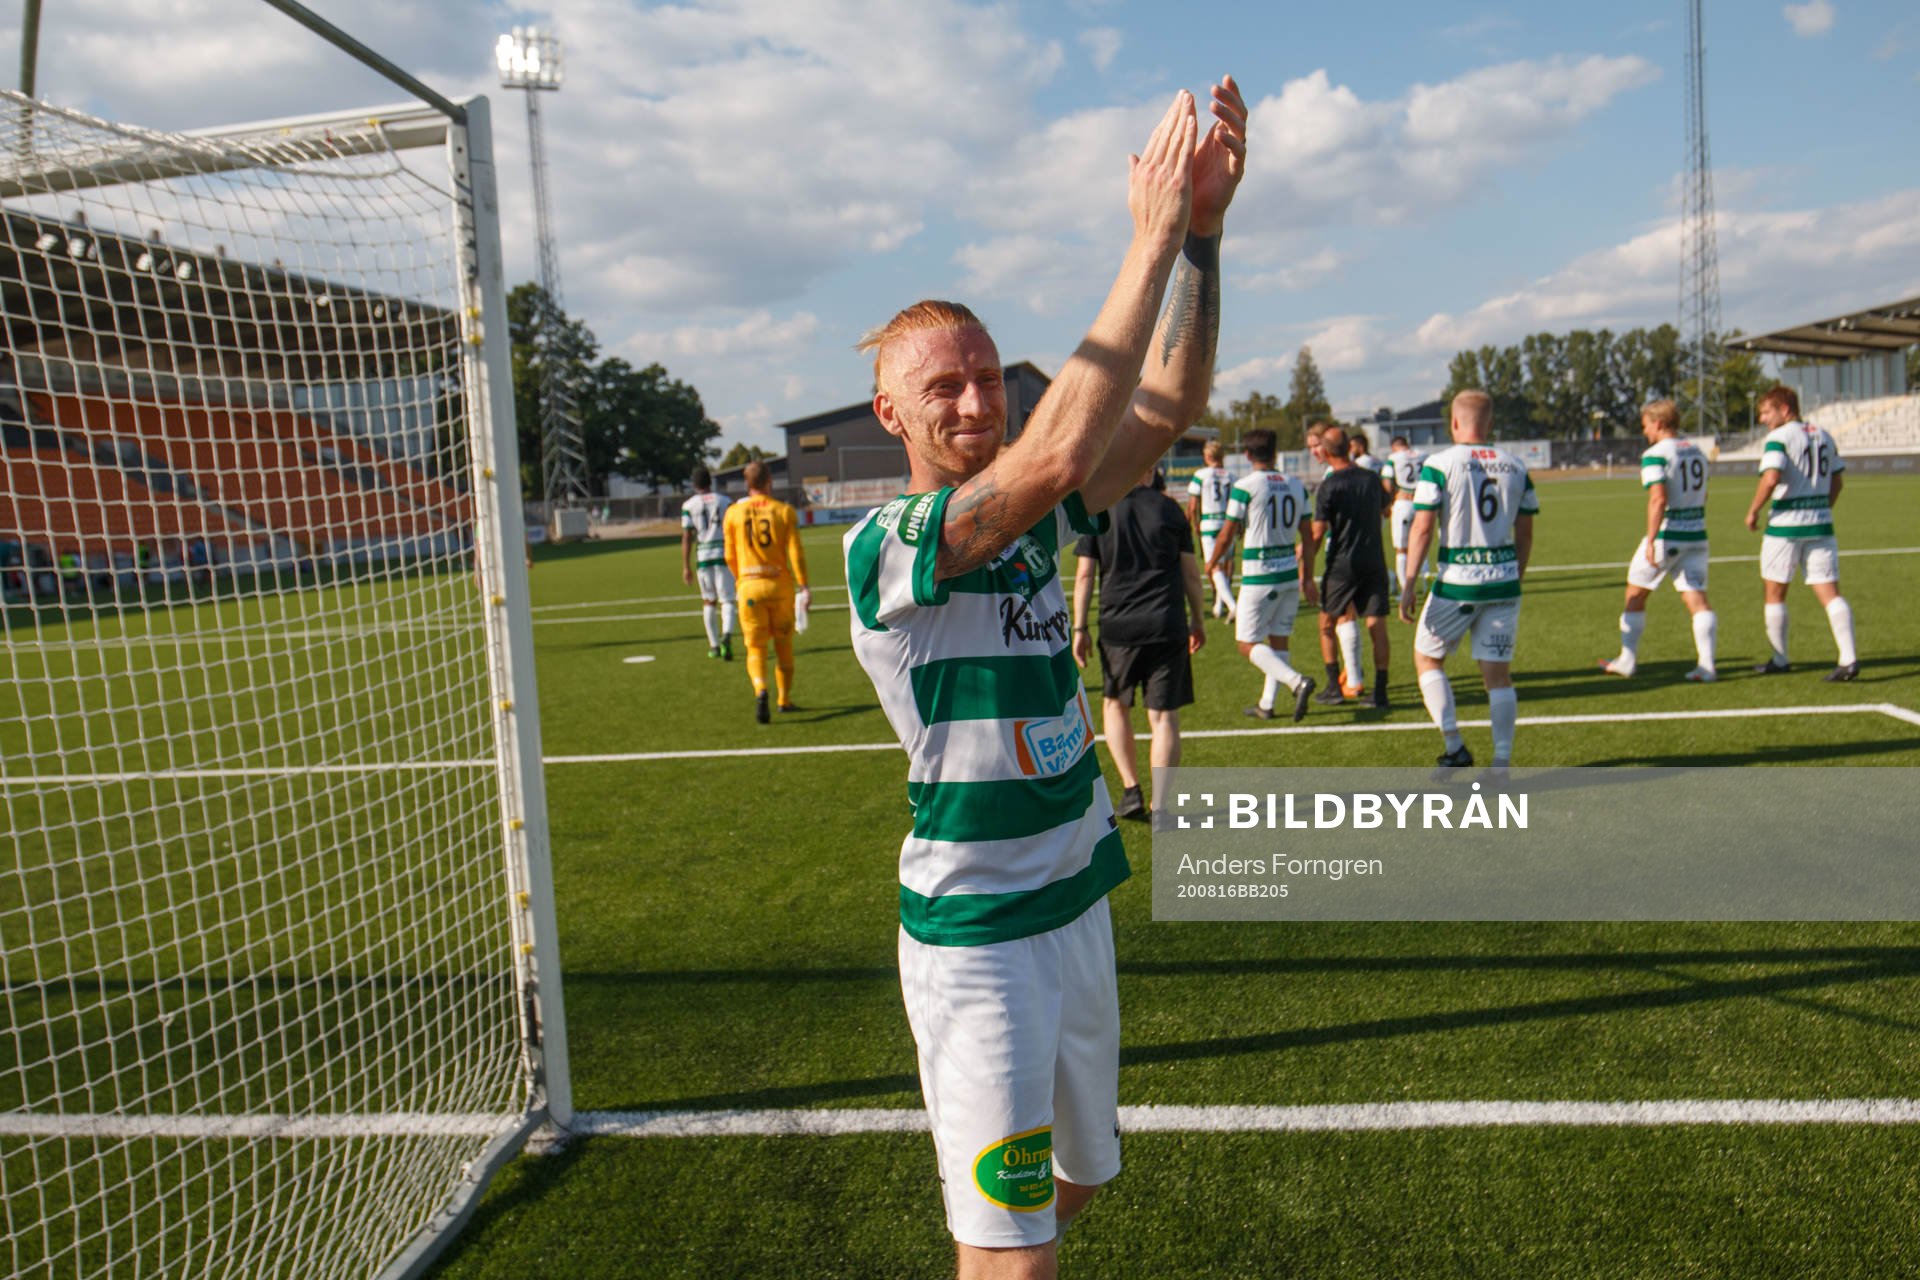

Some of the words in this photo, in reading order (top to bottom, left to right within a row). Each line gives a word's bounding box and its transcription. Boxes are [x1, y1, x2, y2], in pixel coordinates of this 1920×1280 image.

[1680, 459, 1703, 492] 19
[1803, 444, 1828, 478] 16
[1268, 494, 1295, 529] 10
[1478, 478, 1498, 523] 6
[745, 518, 771, 548] 13
